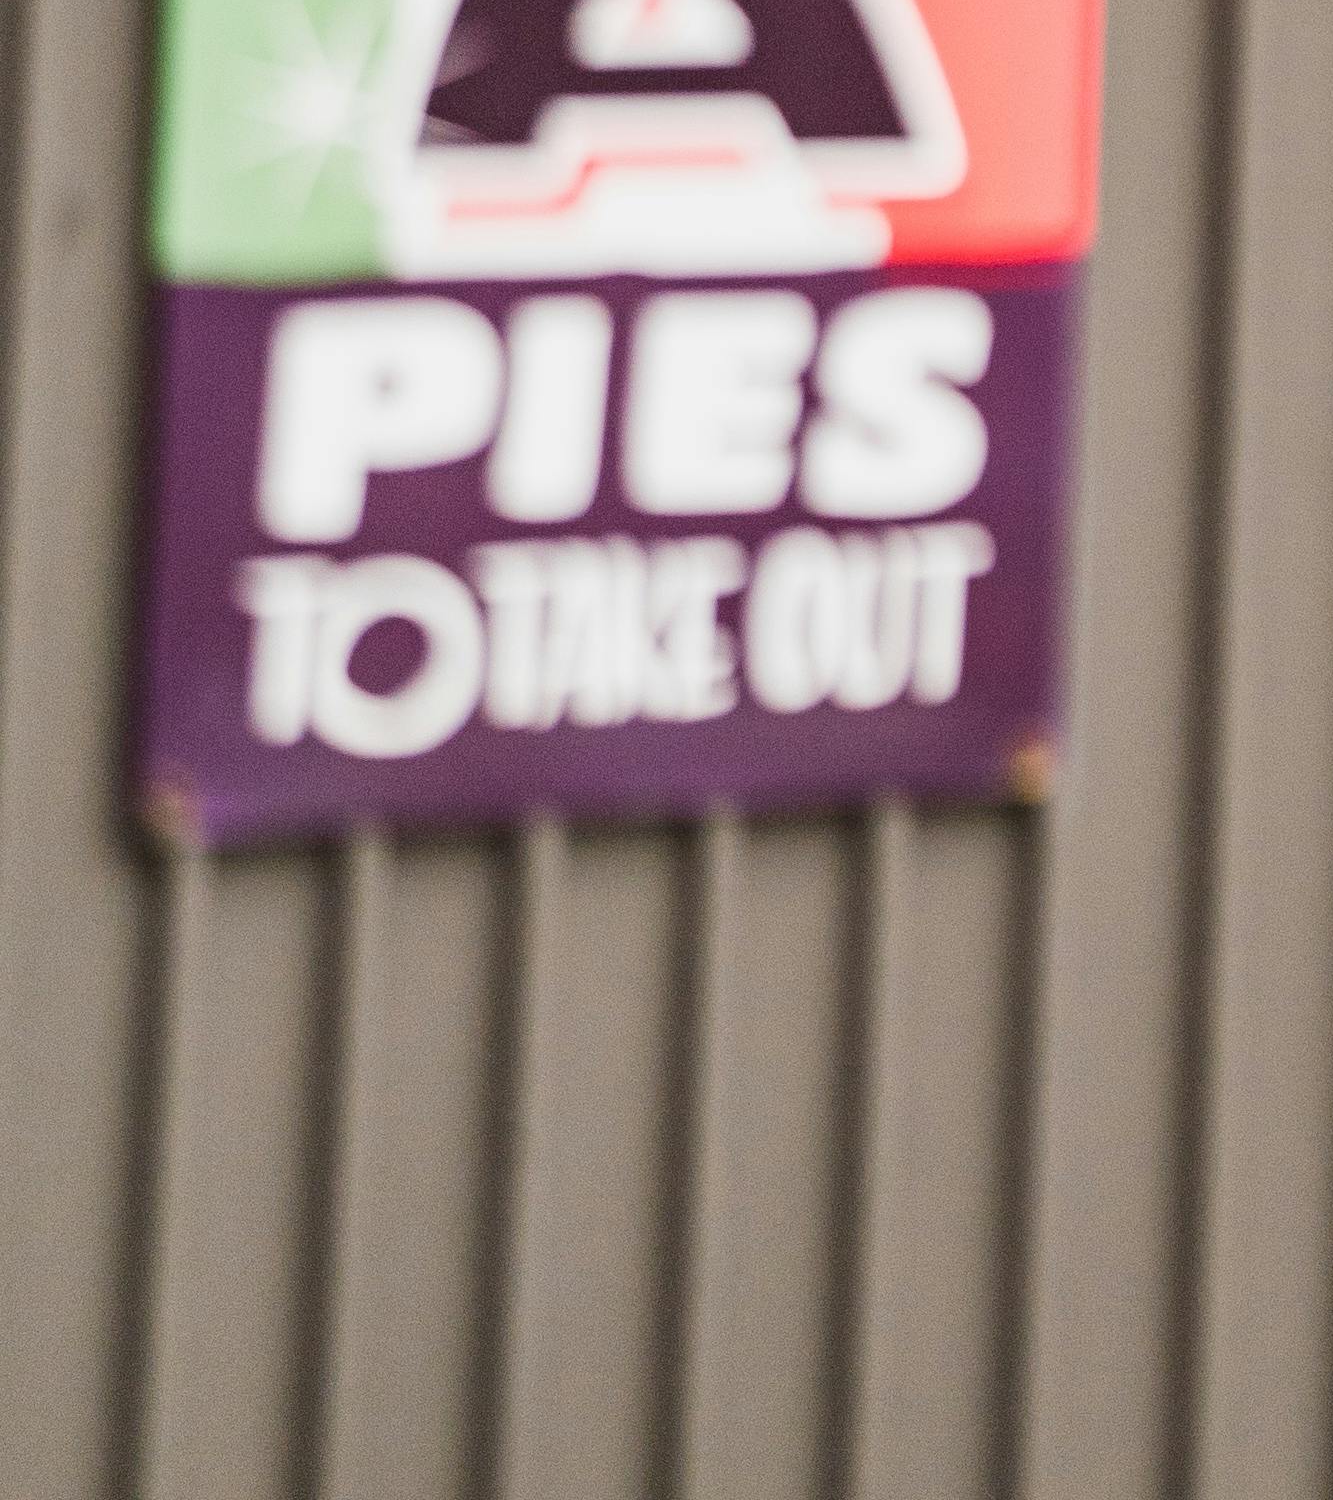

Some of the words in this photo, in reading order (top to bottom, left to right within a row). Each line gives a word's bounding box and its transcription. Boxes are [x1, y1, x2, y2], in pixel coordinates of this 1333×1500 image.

[255, 285, 995, 544] PIES
[235, 550, 486, 760] TO
[470, 533, 749, 732] TAKE
[743, 519, 996, 714] OUT
